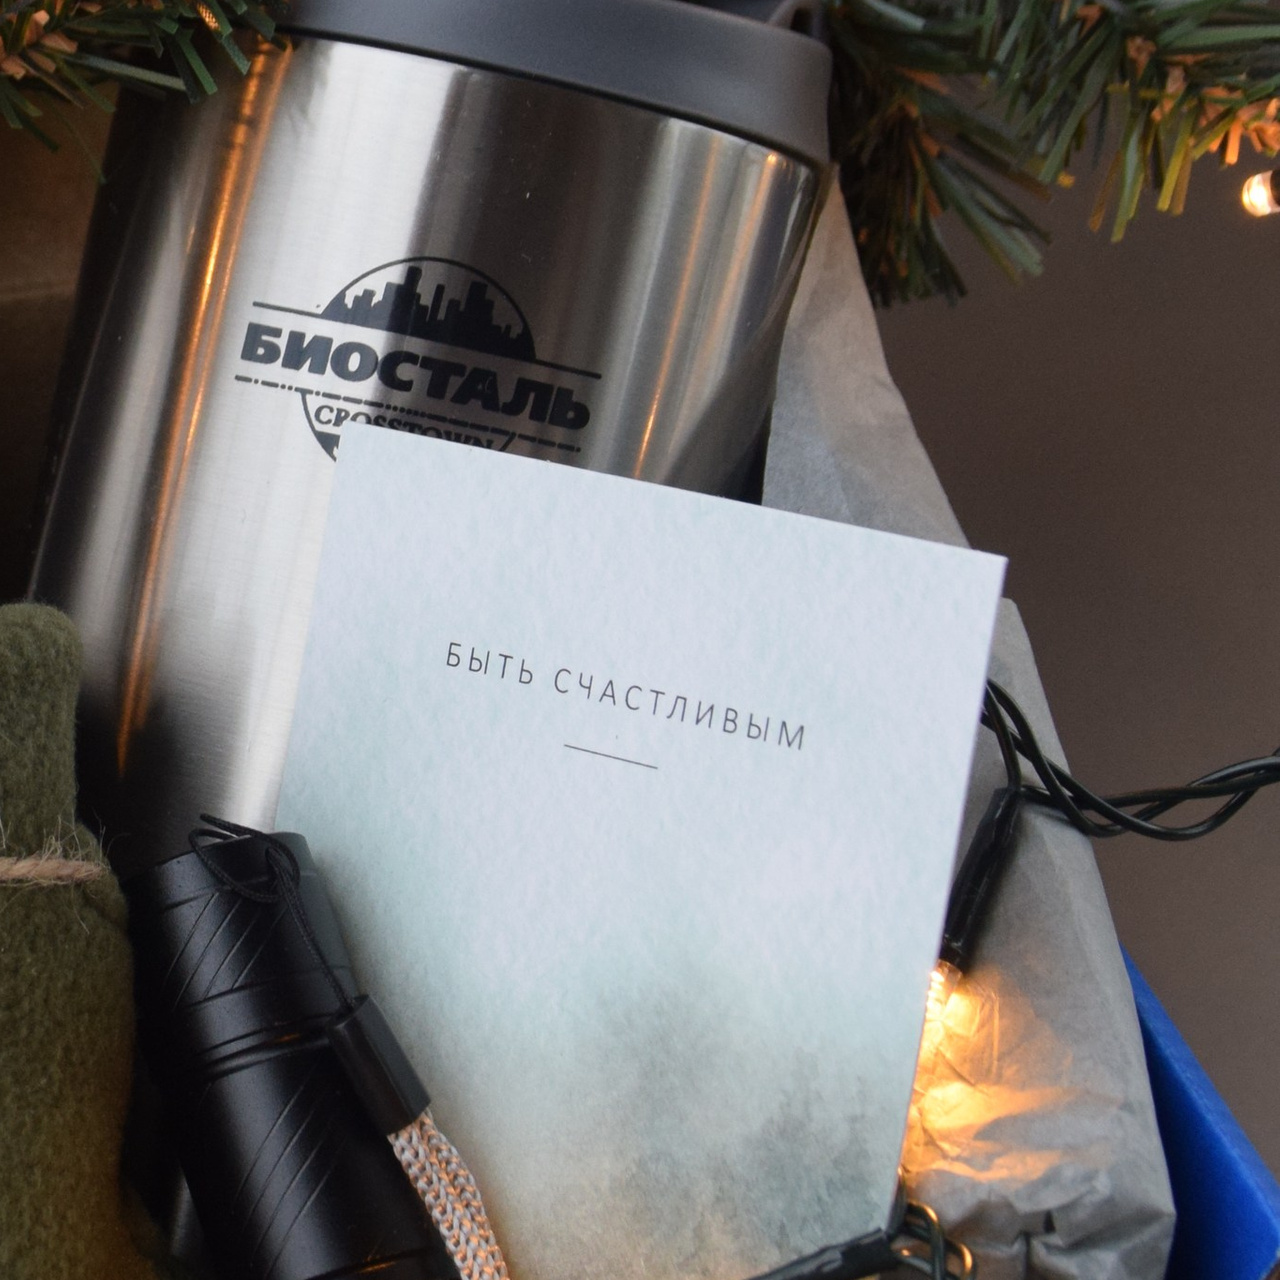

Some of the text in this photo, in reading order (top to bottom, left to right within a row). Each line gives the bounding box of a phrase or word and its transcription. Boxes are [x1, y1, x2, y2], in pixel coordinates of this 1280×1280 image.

[240, 321, 590, 430] БИОСТАЛЬ
[445, 641, 806, 751] БЫТЬ СЧАСТЛИВЫМ
